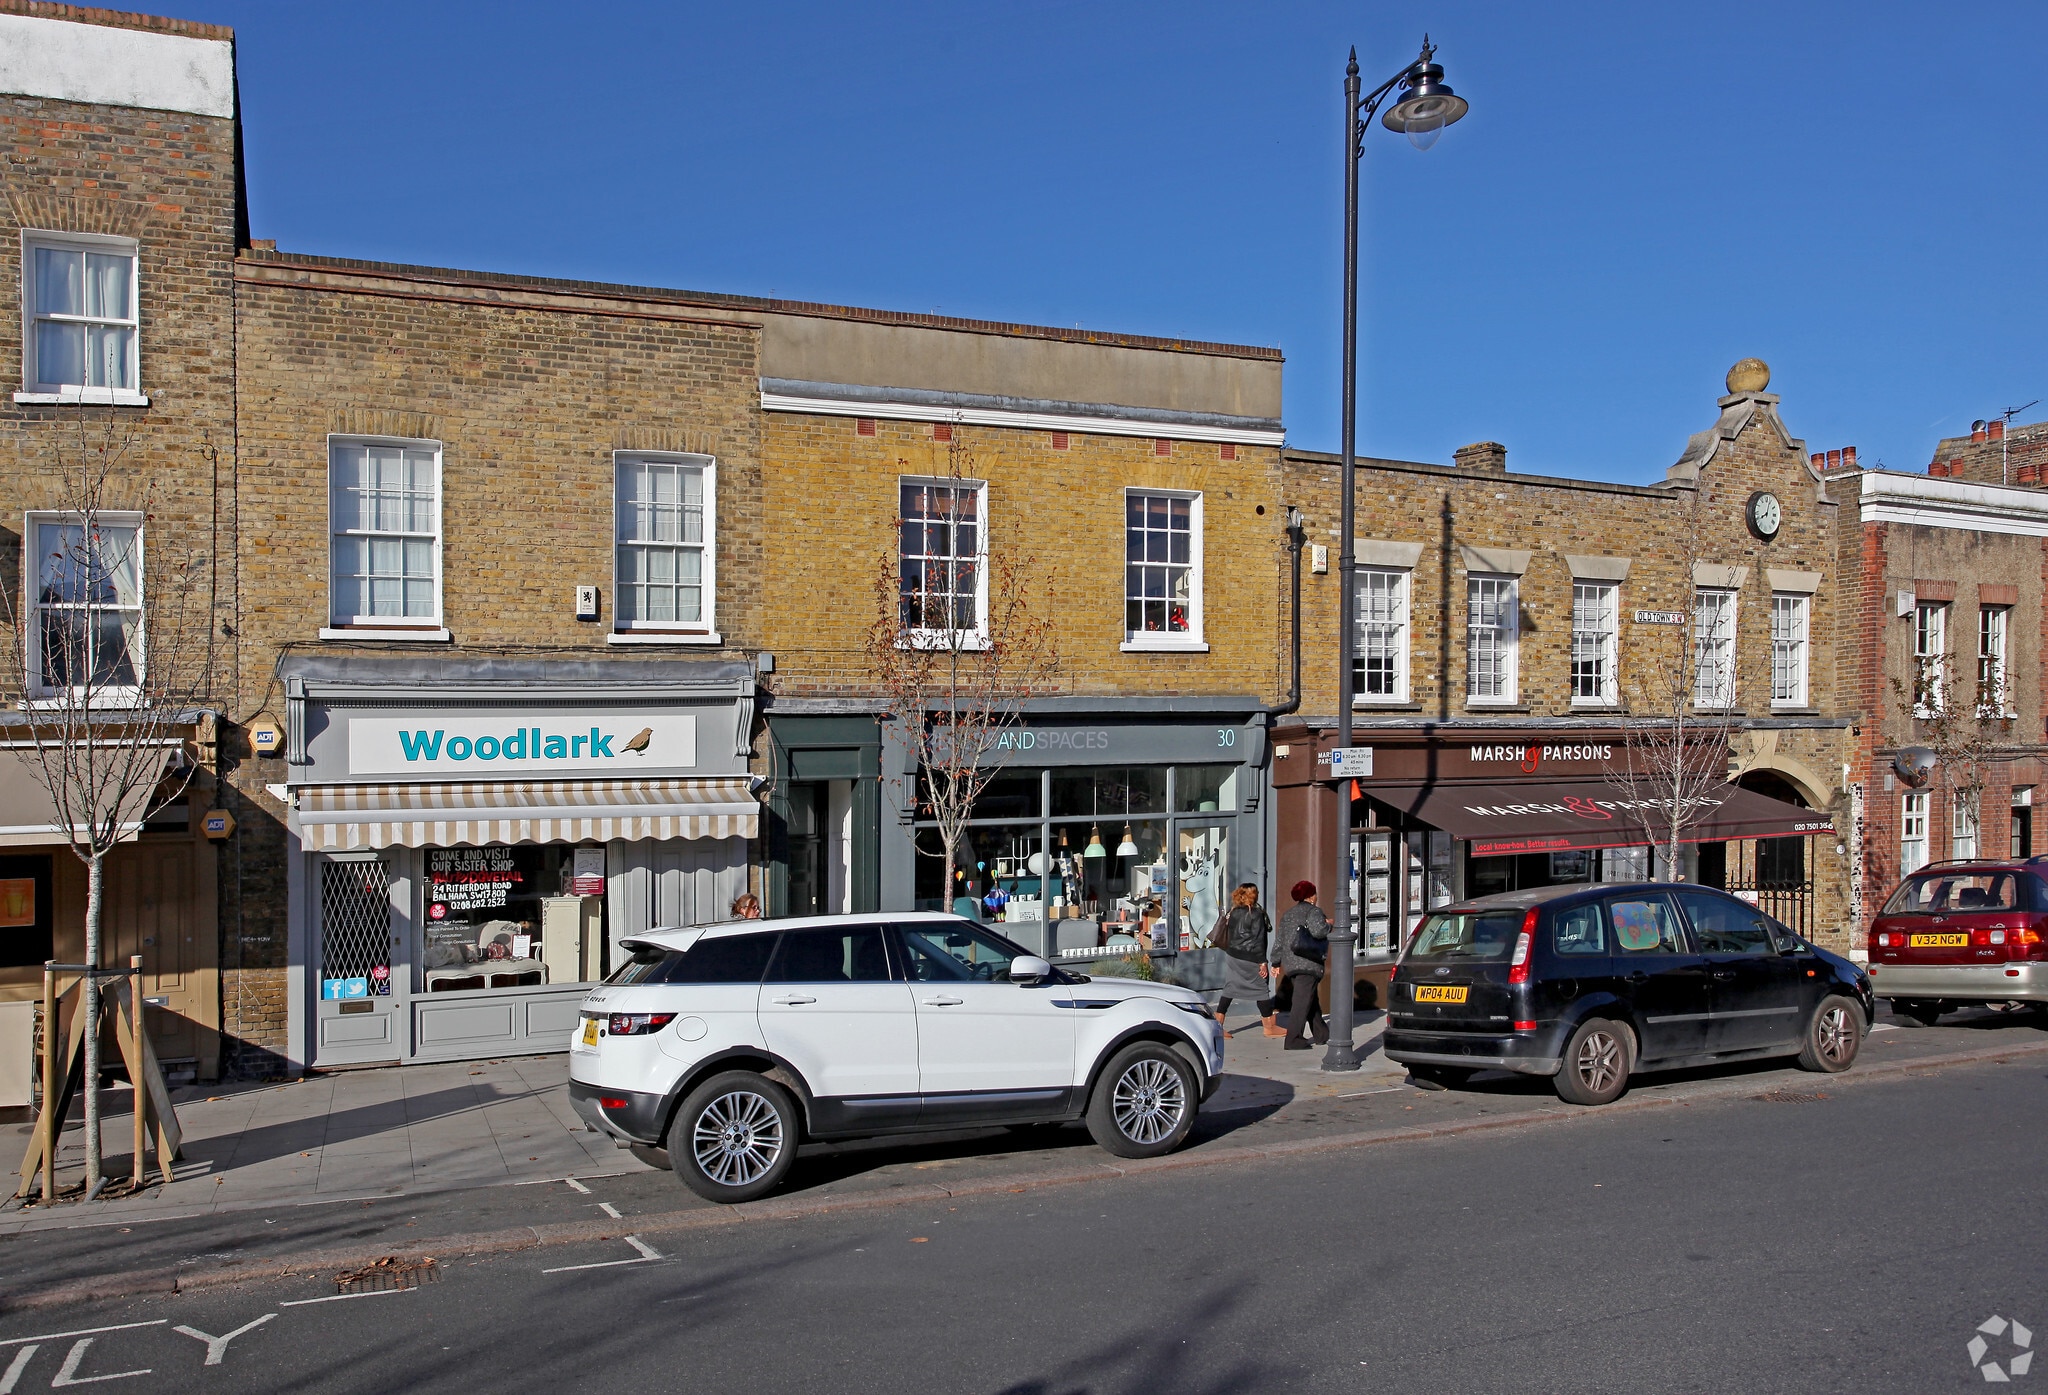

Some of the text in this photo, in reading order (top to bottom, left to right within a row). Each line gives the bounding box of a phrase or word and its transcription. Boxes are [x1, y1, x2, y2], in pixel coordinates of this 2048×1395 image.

[1638, 612, 1652, 621] OLD
[1653, 613, 1670, 622] TOWN
[257, 733, 273, 742] ADT
[1036, 731, 1109, 750] SPACES
[1217, 728, 1235, 747] 30
[398, 727, 616, 762] Woodlark
[1471, 745, 1525, 762] MARSH
[1543, 745, 1612, 761] PARSONS
[1463, 803, 1574, 816] MARSH
[207, 823, 224, 831] ADT
[1794, 823, 1805, 831] 020
[1806, 822, 1818, 830] 7501
[1475, 843, 1492, 851] Local
[1527, 839, 1546, 848] Better
[1547, 838, 1570, 846] results.
[432, 847, 511, 861] COME AND VISIT
[431, 860, 515, 871] OUR SISTER SHOP
[469, 871, 523, 884] DOVETAIL
[432, 882, 512, 893] 24 RITHERDON ROAD
[432, 892, 468, 901] BALHAM
[470, 890, 491, 900] SW17
[471, 899, 487, 909] 682
[487, 898, 506, 907] 2522
[1916, 934, 1963, 945] V32 NGW
[1420, 987, 1464, 1000] WP04 AUU
